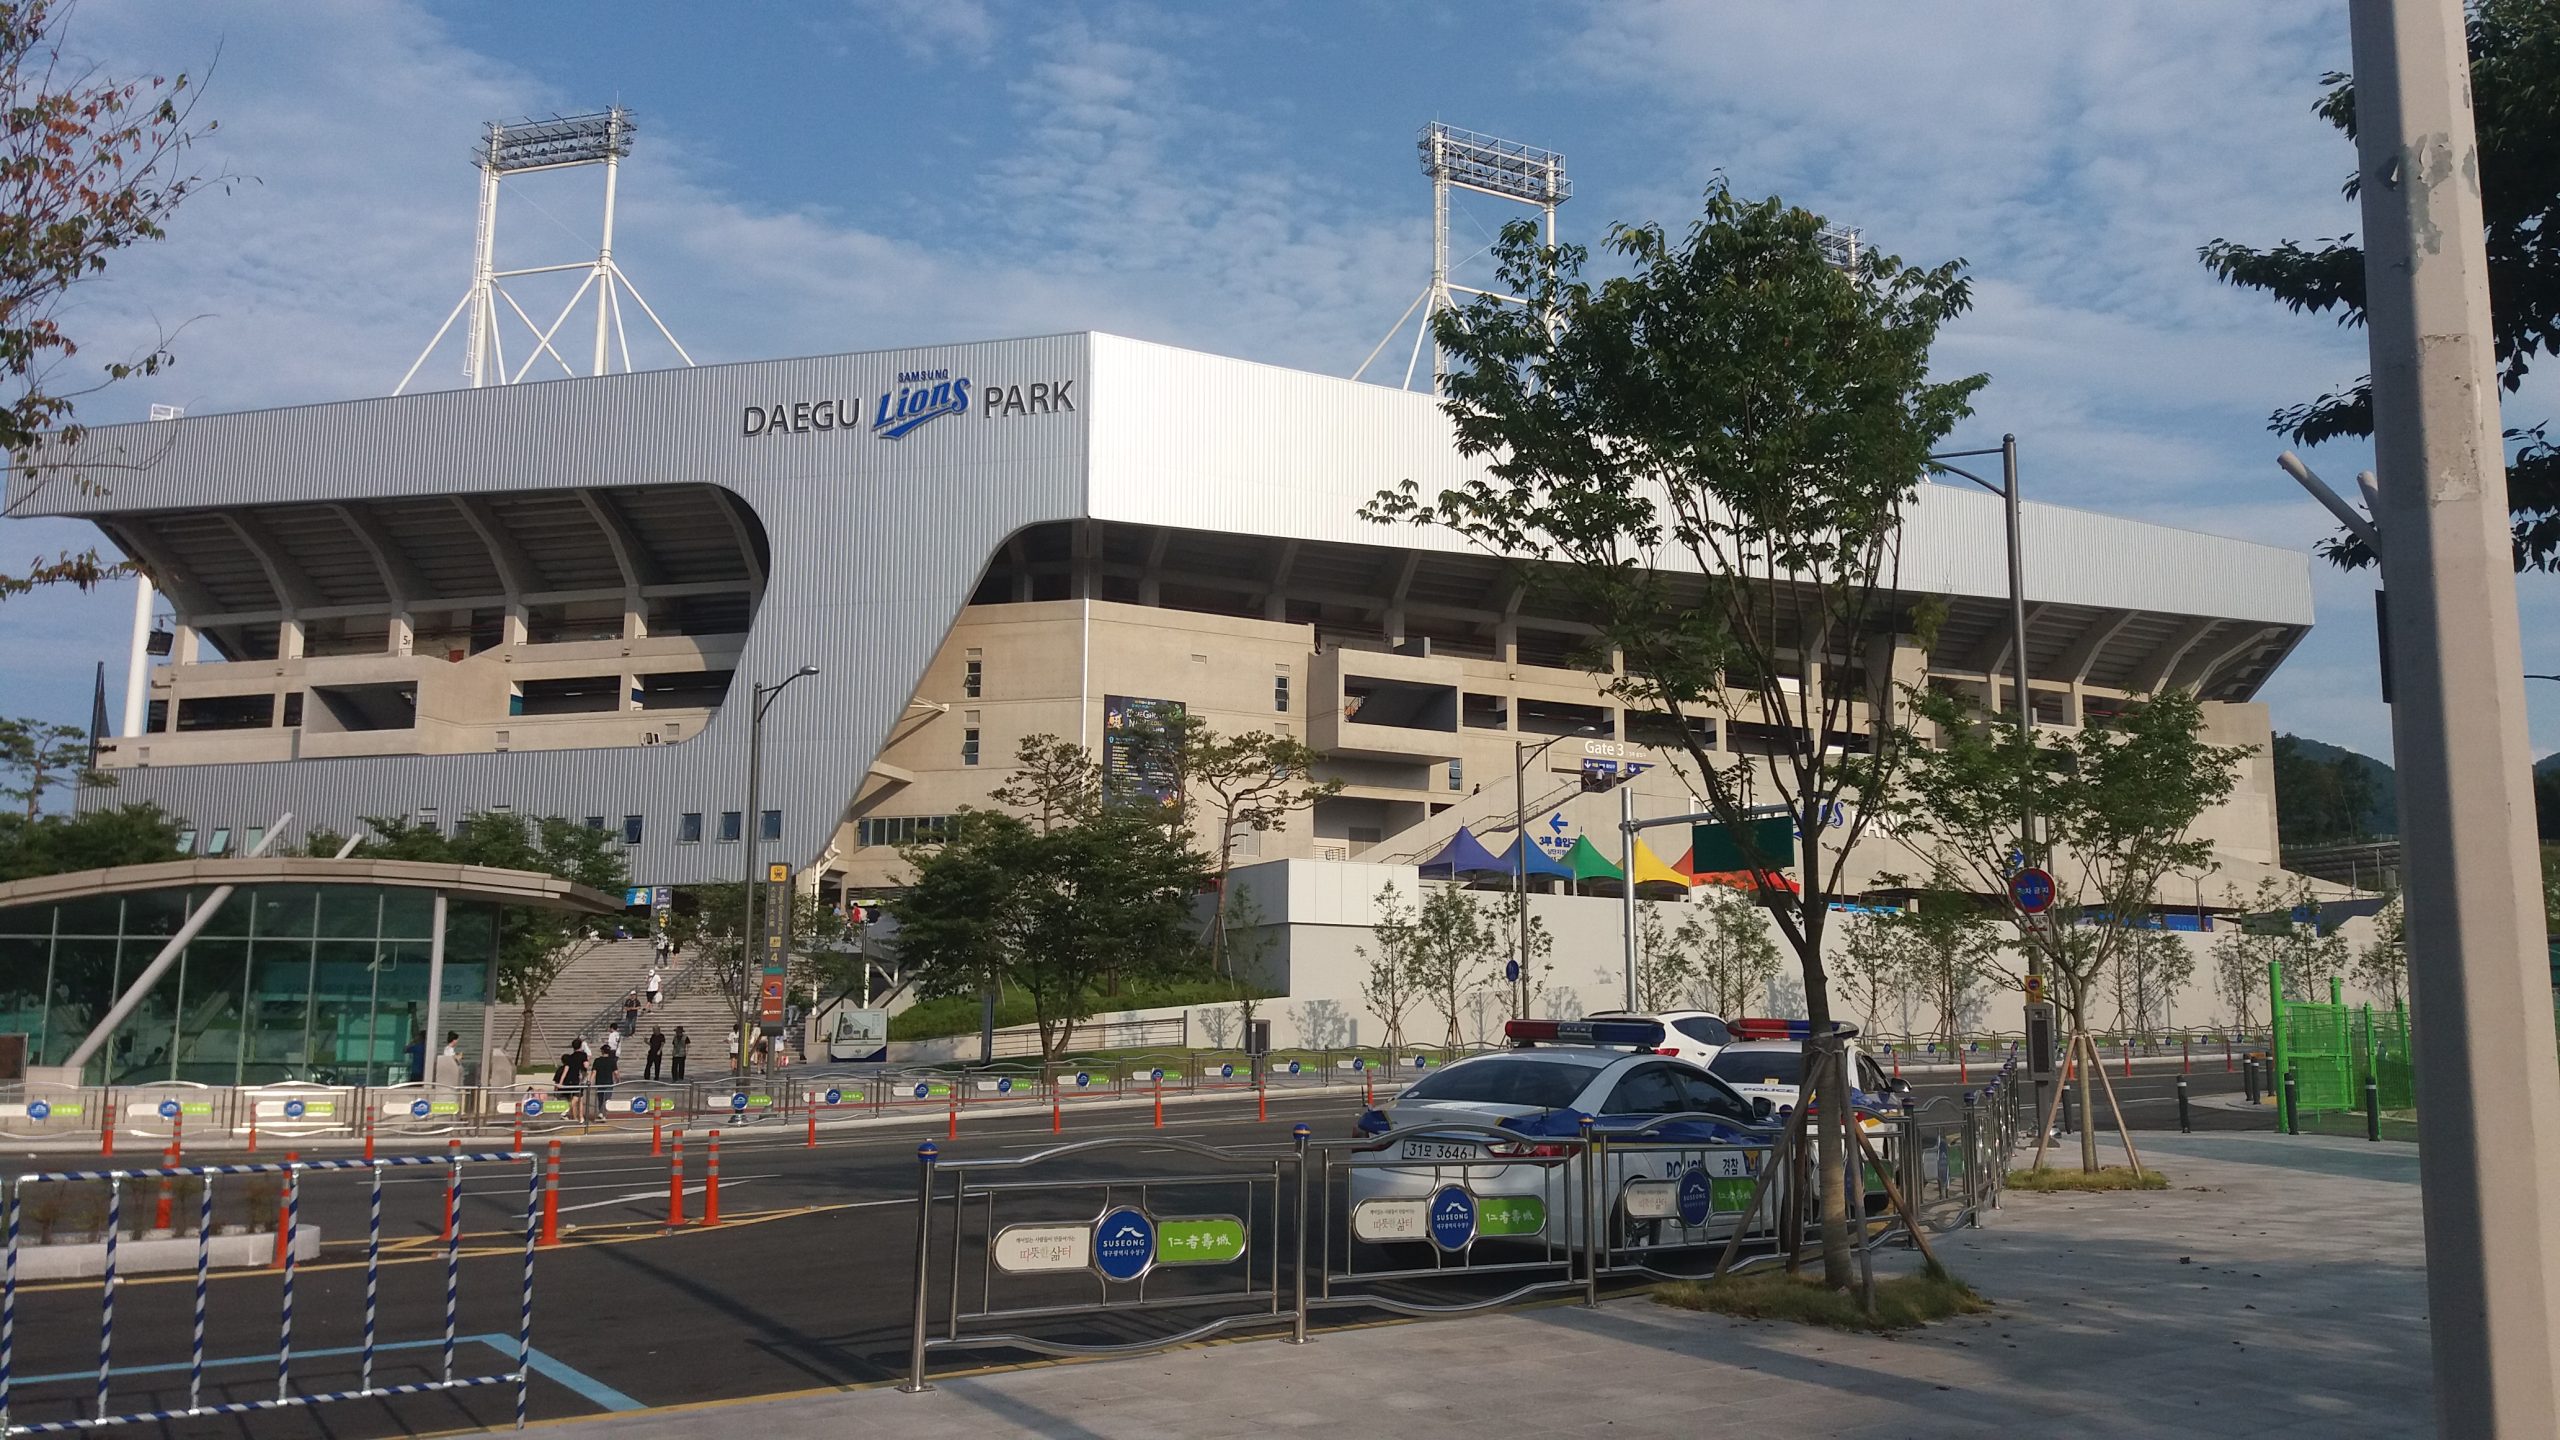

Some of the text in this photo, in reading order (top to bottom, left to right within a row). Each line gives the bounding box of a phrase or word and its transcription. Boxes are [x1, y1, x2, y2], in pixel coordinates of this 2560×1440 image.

[898, 368, 949, 382] SAMSUNG
[743, 376, 1075, 437] DAEGU Lions PARK
[1584, 740, 1625, 756] Gate 3
[1539, 836, 1552, 846] 3루
[770, 953, 778, 962] 4
[1409, 1143, 1468, 1159] 31모 3646
[1723, 1158, 1738, 1175] 경찰
[1436, 1213, 1469, 1221] SUSEONG
[1103, 1239, 1145, 1247] SUSEONG
